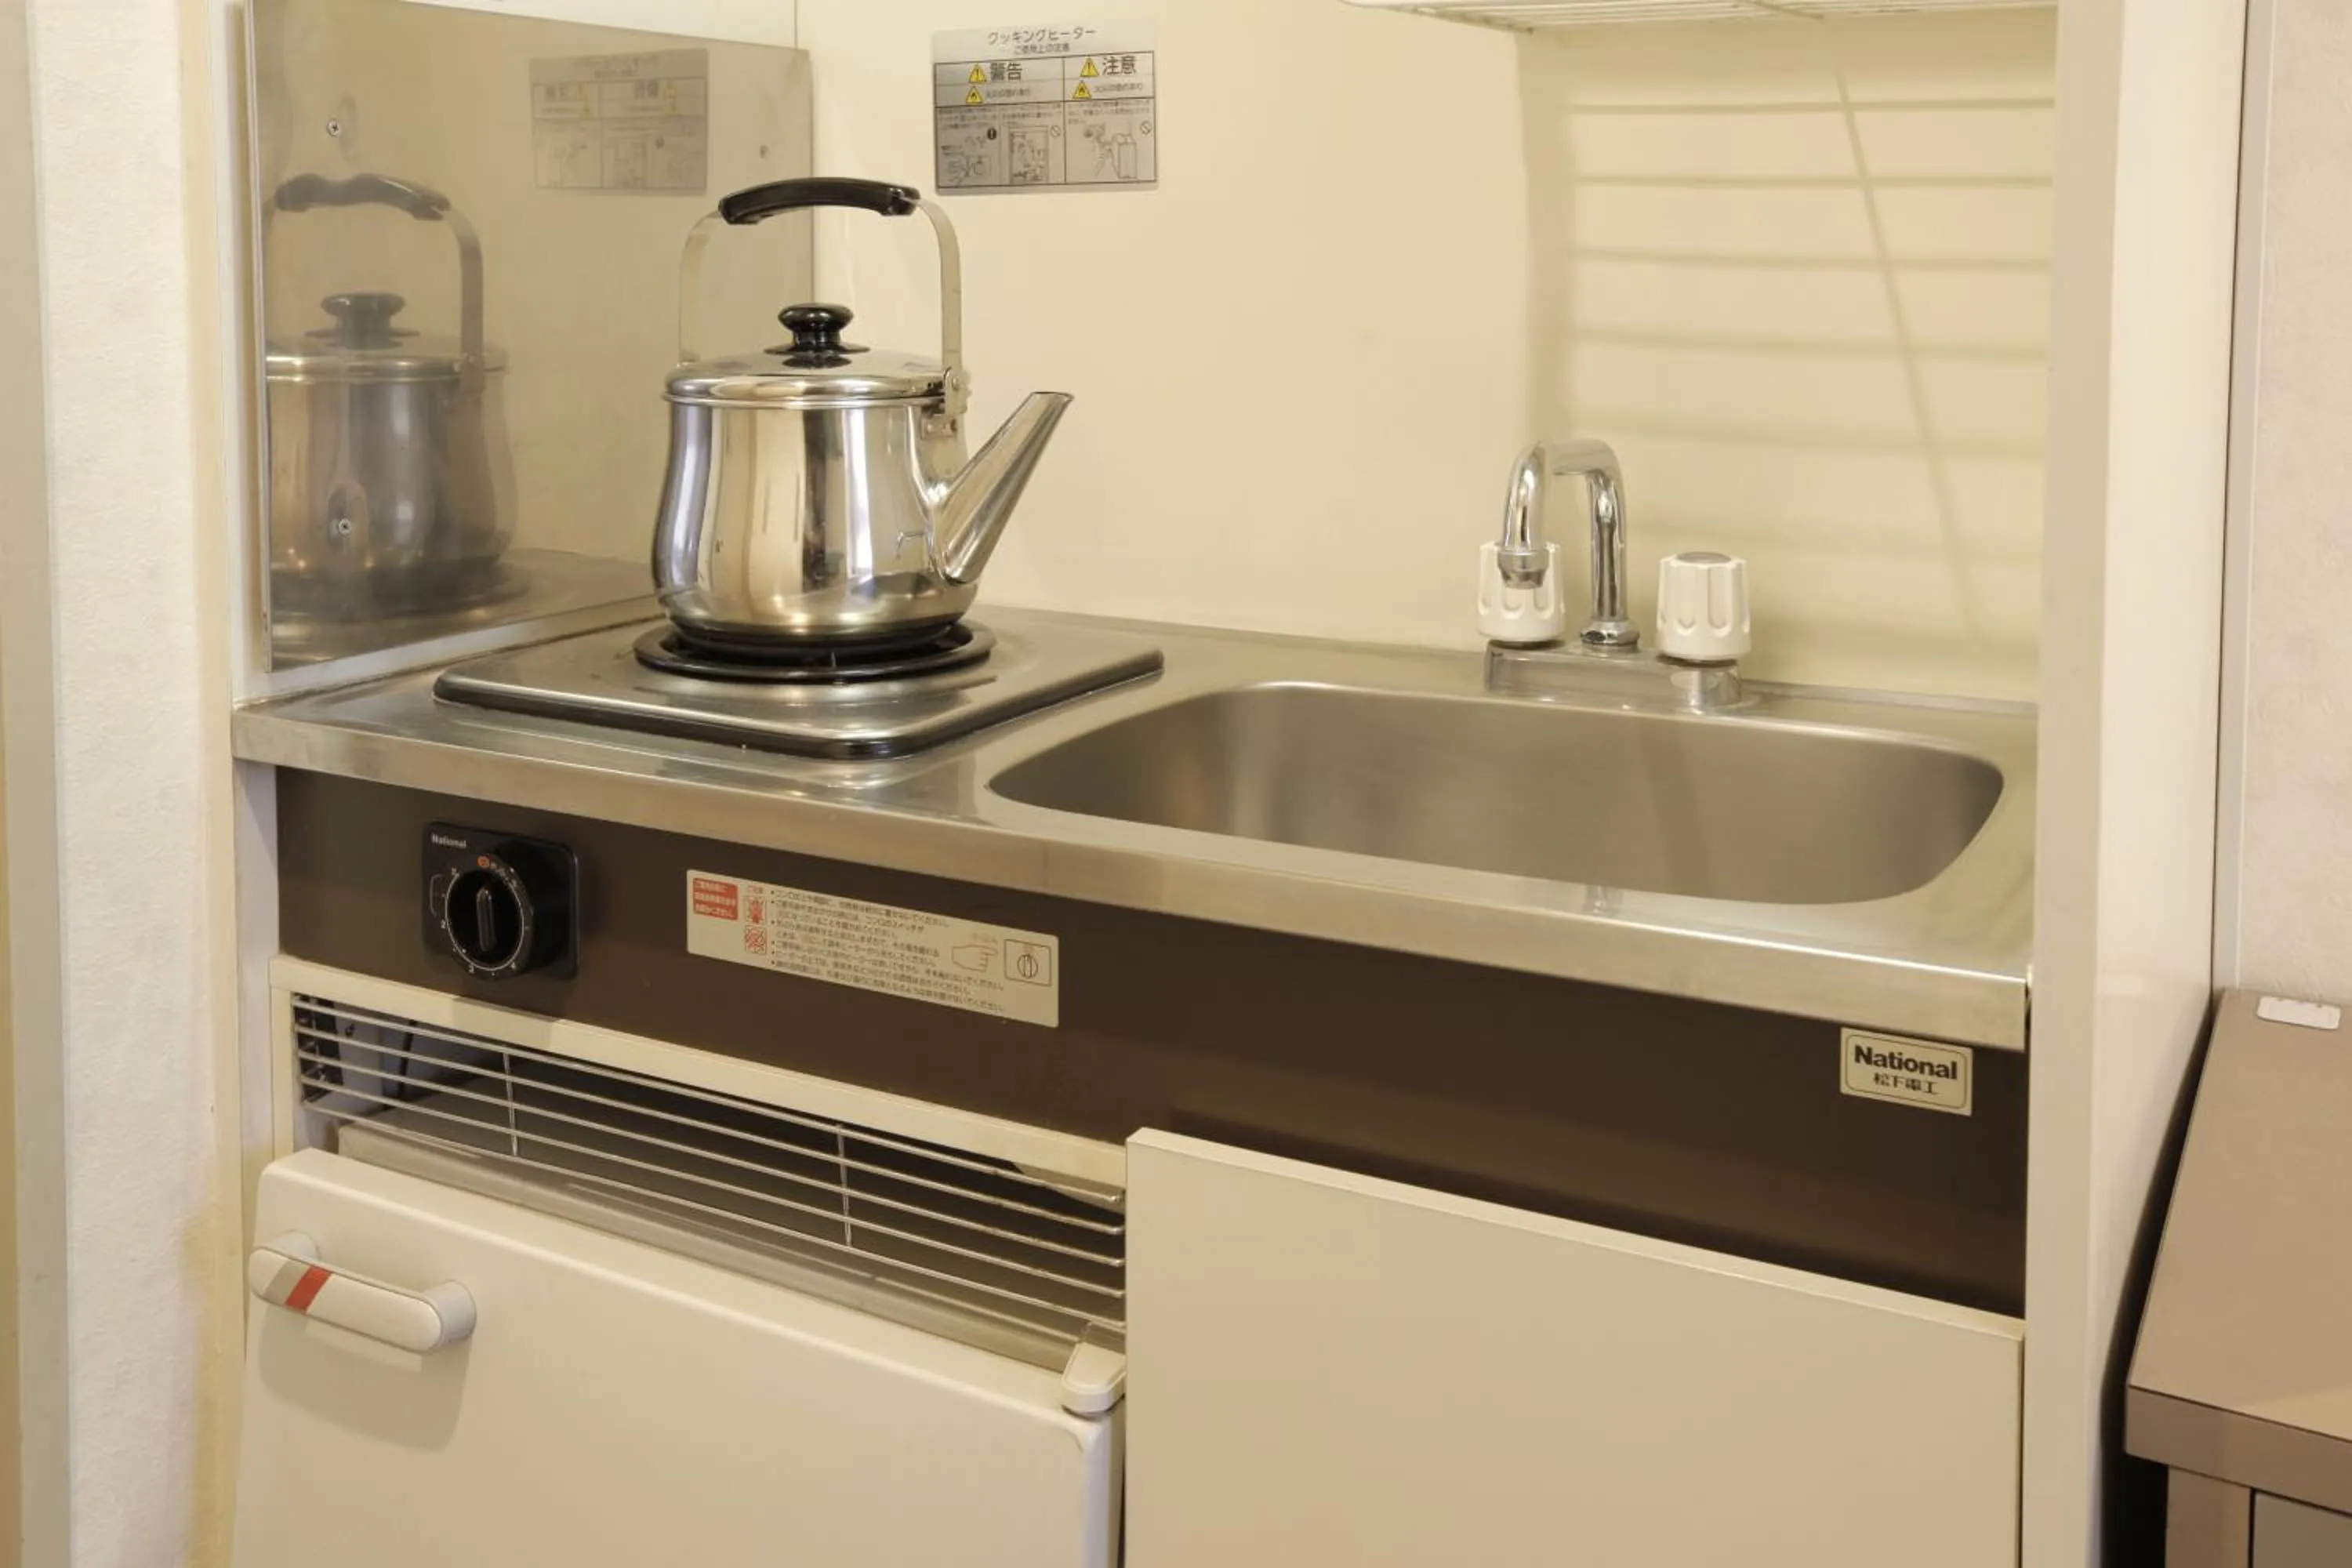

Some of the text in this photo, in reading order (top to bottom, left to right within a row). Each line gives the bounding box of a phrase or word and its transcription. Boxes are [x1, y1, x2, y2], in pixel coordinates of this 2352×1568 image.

[988, 27, 1097, 45] クッキングヒーター
[989, 62, 1022, 81] 警告
[1102, 56, 1136, 76] 注意
[432, 833, 467, 849] National
[1854, 1044, 1958, 1080] National
[1874, 1073, 1941, 1095] 松下電工
